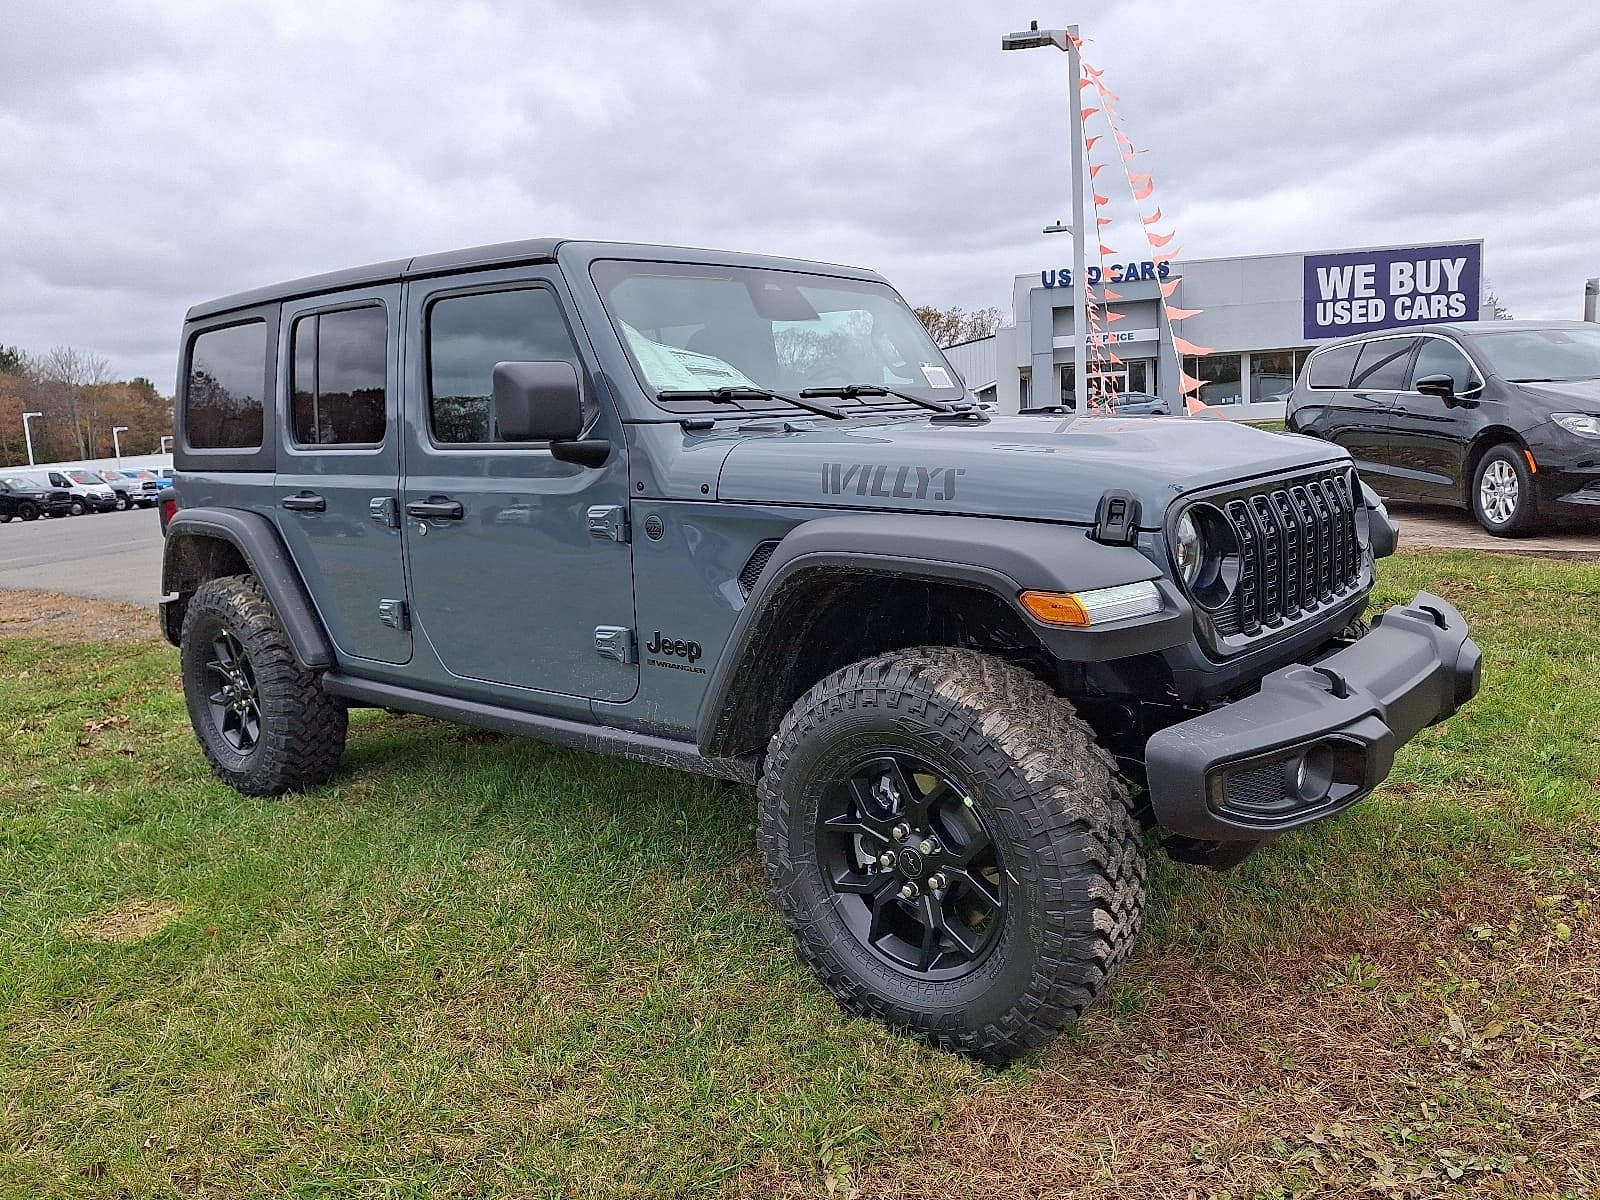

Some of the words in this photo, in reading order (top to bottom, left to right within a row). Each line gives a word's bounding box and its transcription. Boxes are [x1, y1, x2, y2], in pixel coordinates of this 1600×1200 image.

[1041, 266, 1101, 289] USD
[1110, 260, 1170, 284] CARS
[1316, 263, 1376, 300] WE
[1389, 257, 1467, 296] BUY
[1316, 299, 1386, 326] USED
[1394, 293, 1467, 321] CARS
[1102, 332, 1134, 343] PICE
[821, 463, 966, 501] WILLYS
[646, 630, 702, 663] Jeep
[655, 660, 706, 675] WRANGLER
